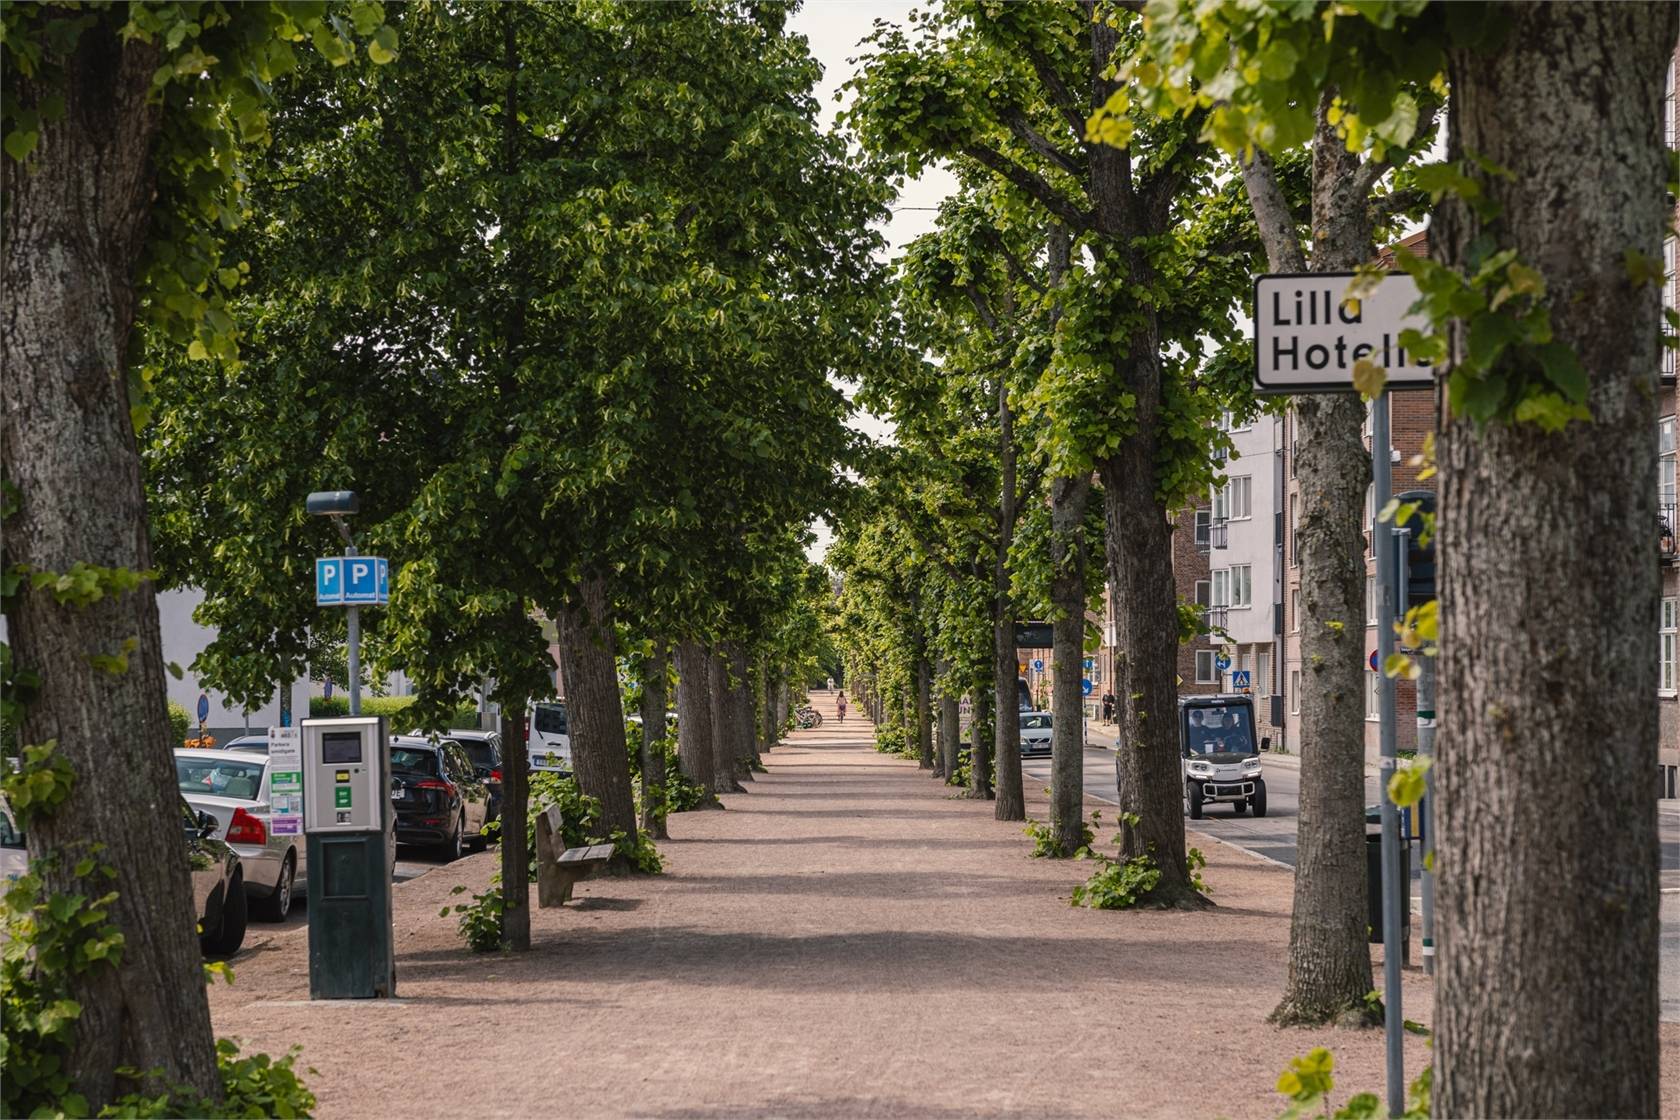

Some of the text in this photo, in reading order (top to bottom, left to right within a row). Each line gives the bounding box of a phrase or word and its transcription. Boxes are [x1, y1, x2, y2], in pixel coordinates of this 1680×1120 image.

[1273, 290, 1362, 326] Lilla
[1273, 333, 1431, 370] Hotell
[323, 564, 336, 586] P
[352, 563, 369, 585] P
[380, 563, 386, 585] P
[345, 591, 376, 599] Automat
